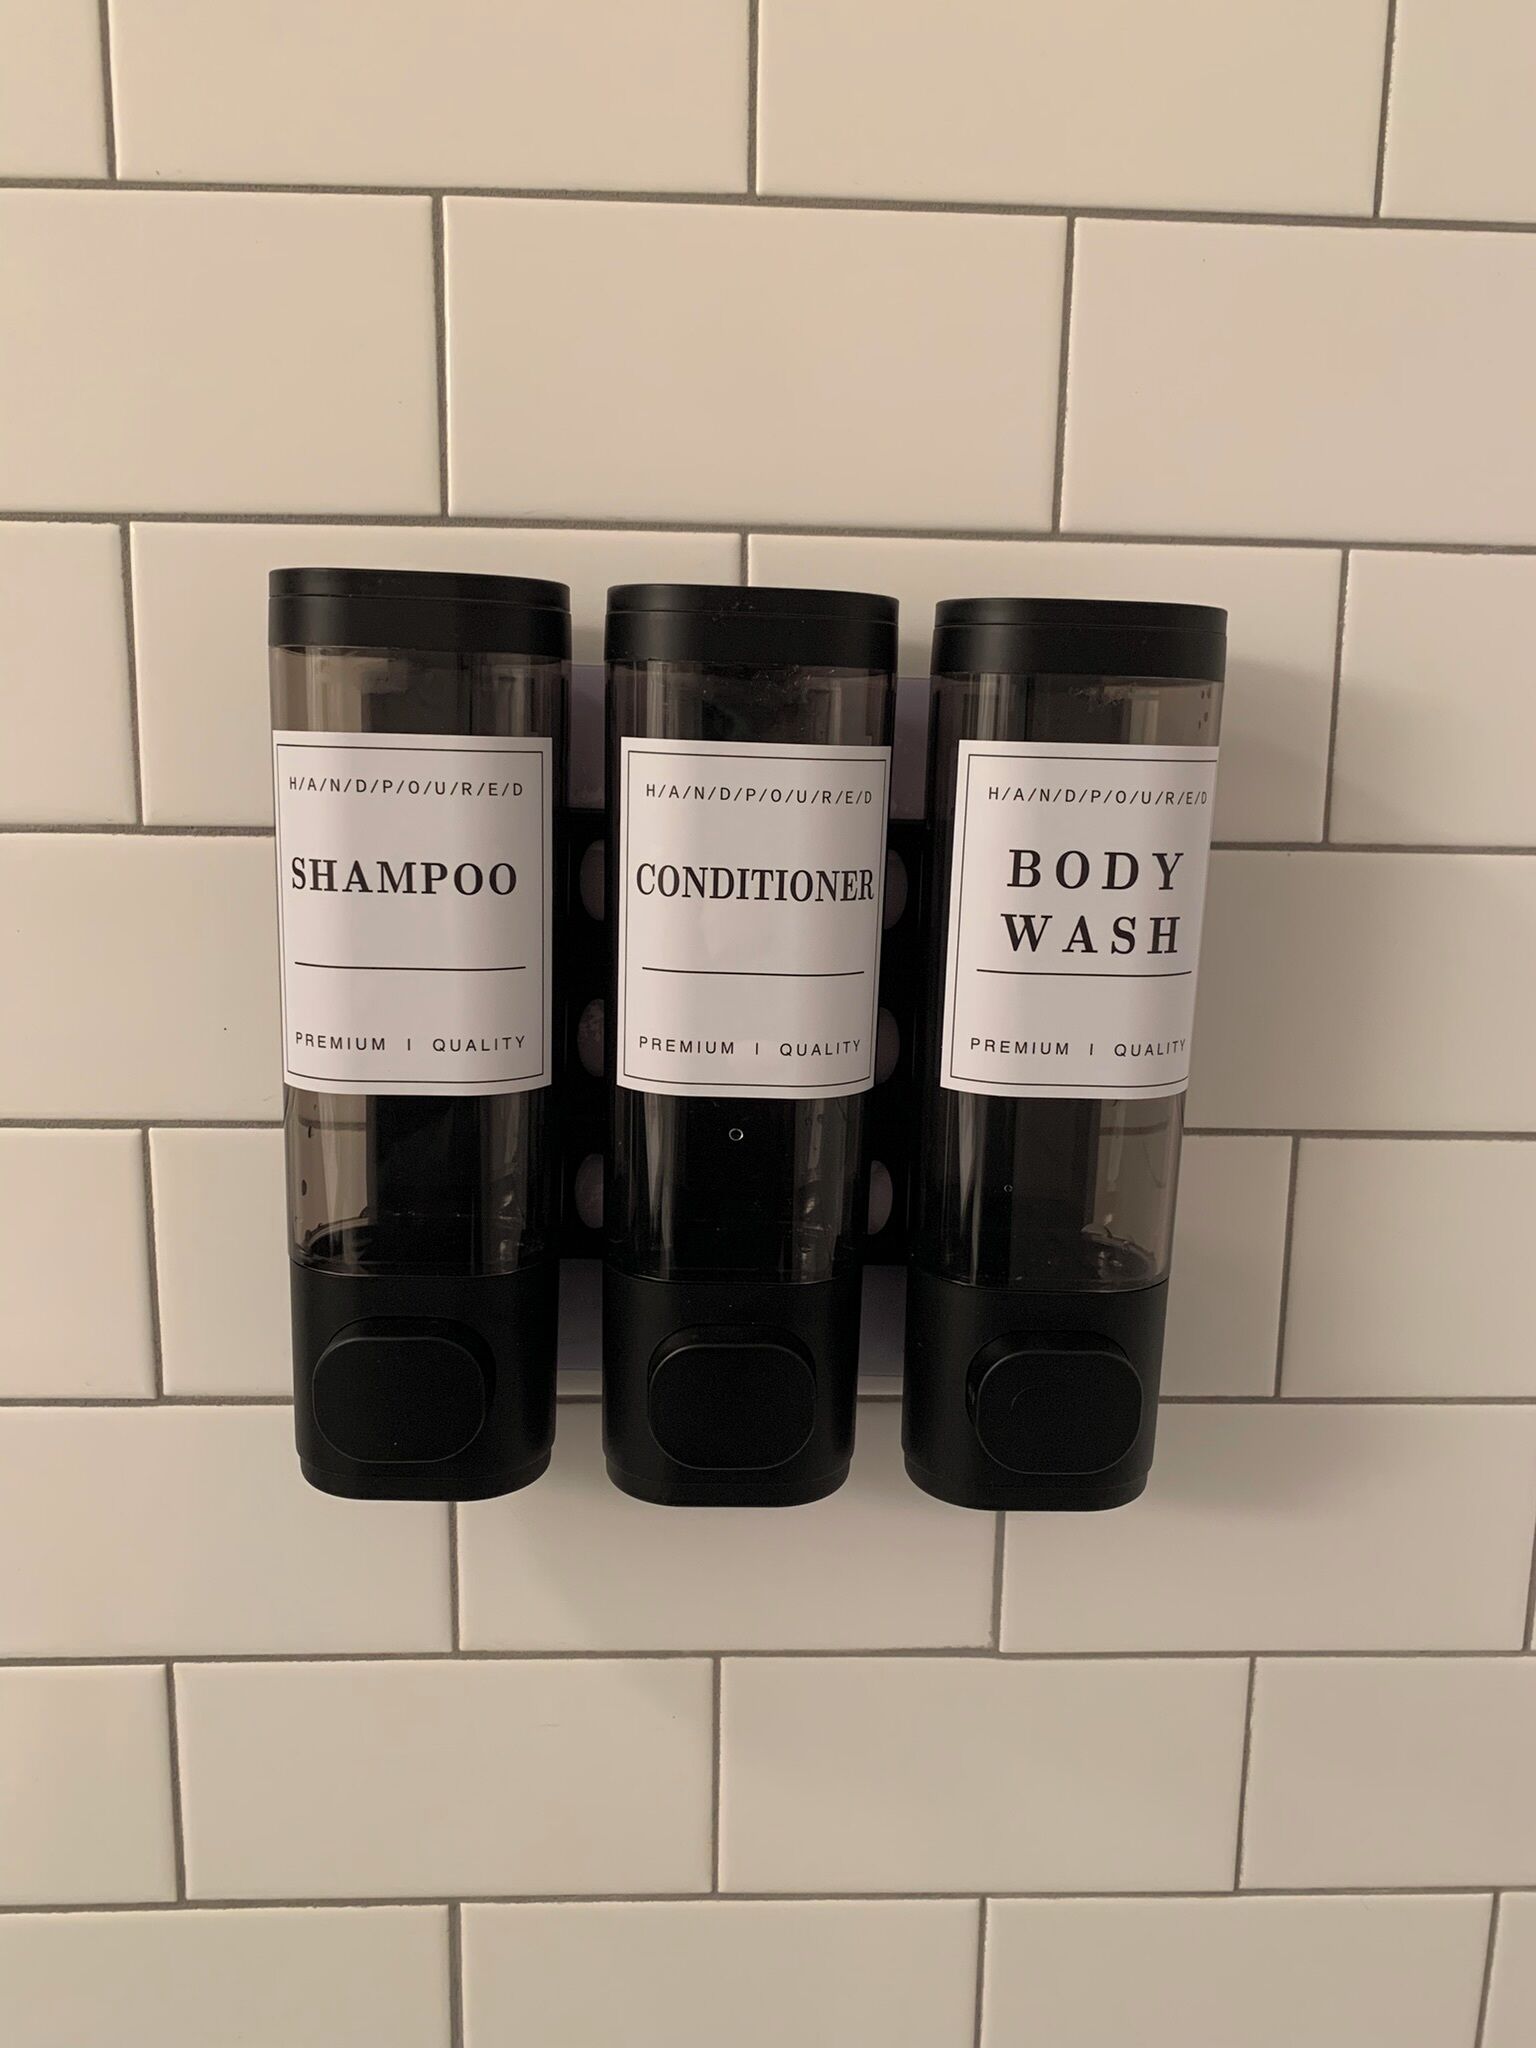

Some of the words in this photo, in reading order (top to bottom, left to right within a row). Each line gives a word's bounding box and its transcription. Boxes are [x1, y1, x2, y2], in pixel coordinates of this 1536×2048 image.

[288, 775, 524, 797] H/A/N/D/P/O/U/R/E/D
[645, 783, 873, 805] H/A/N/D/P/O/U/R/E/D
[988, 786, 1208, 806] H/A/N/D/P/O/U/R/E/D
[291, 856, 517, 896] SHAMPOO
[1006, 848, 1185, 891] BODY
[636, 862, 875, 903] CONDITIONER
[999, 912, 1181, 955] WASH
[295, 1031, 386, 1051] PREMIUM
[432, 1035, 526, 1053] QUALITY
[638, 1035, 734, 1055] PREMIUM
[779, 1039, 862, 1057] QUALITY
[970, 1037, 1069, 1056] PREMIUM
[1113, 1038, 1187, 1058] QUALITY
